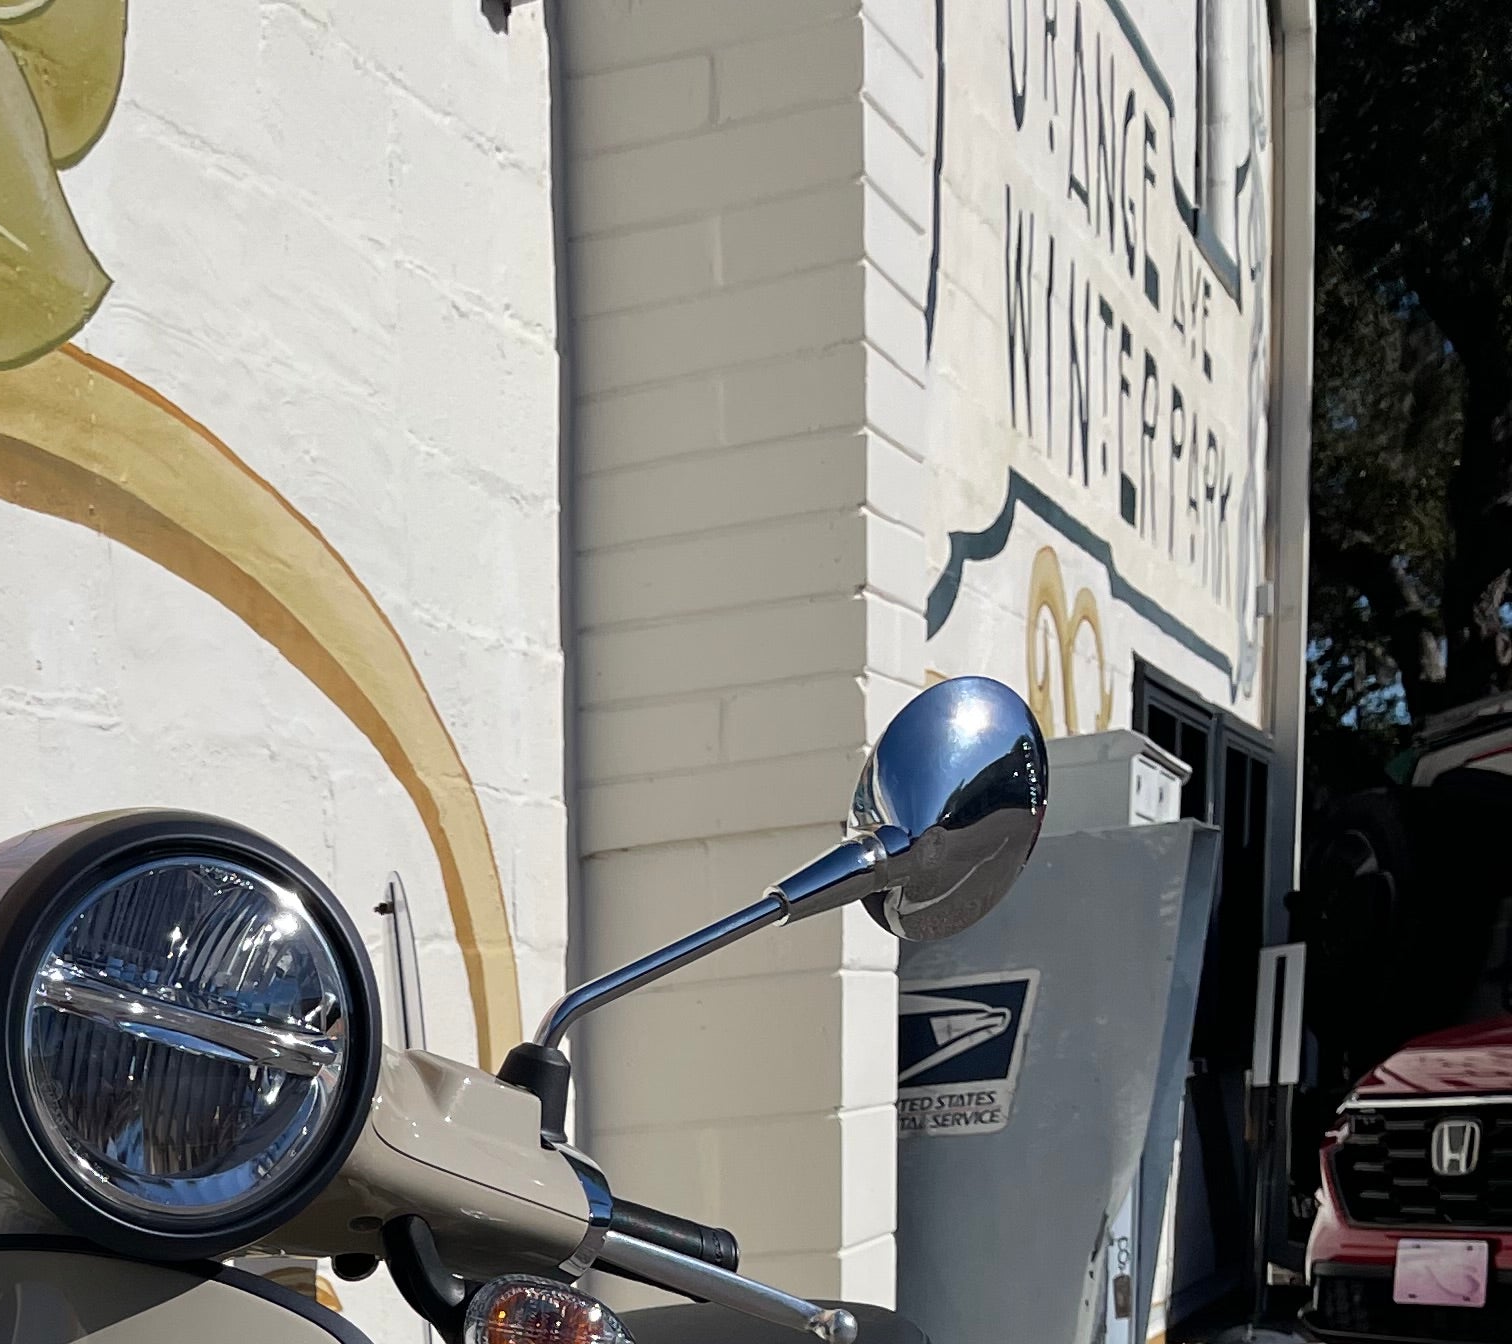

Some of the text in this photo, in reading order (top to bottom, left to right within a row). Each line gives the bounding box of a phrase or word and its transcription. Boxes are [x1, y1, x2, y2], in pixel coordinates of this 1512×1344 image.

[898, 1090, 997, 1112] TED STATES
[929, 1107, 1001, 1129] SERVICE
